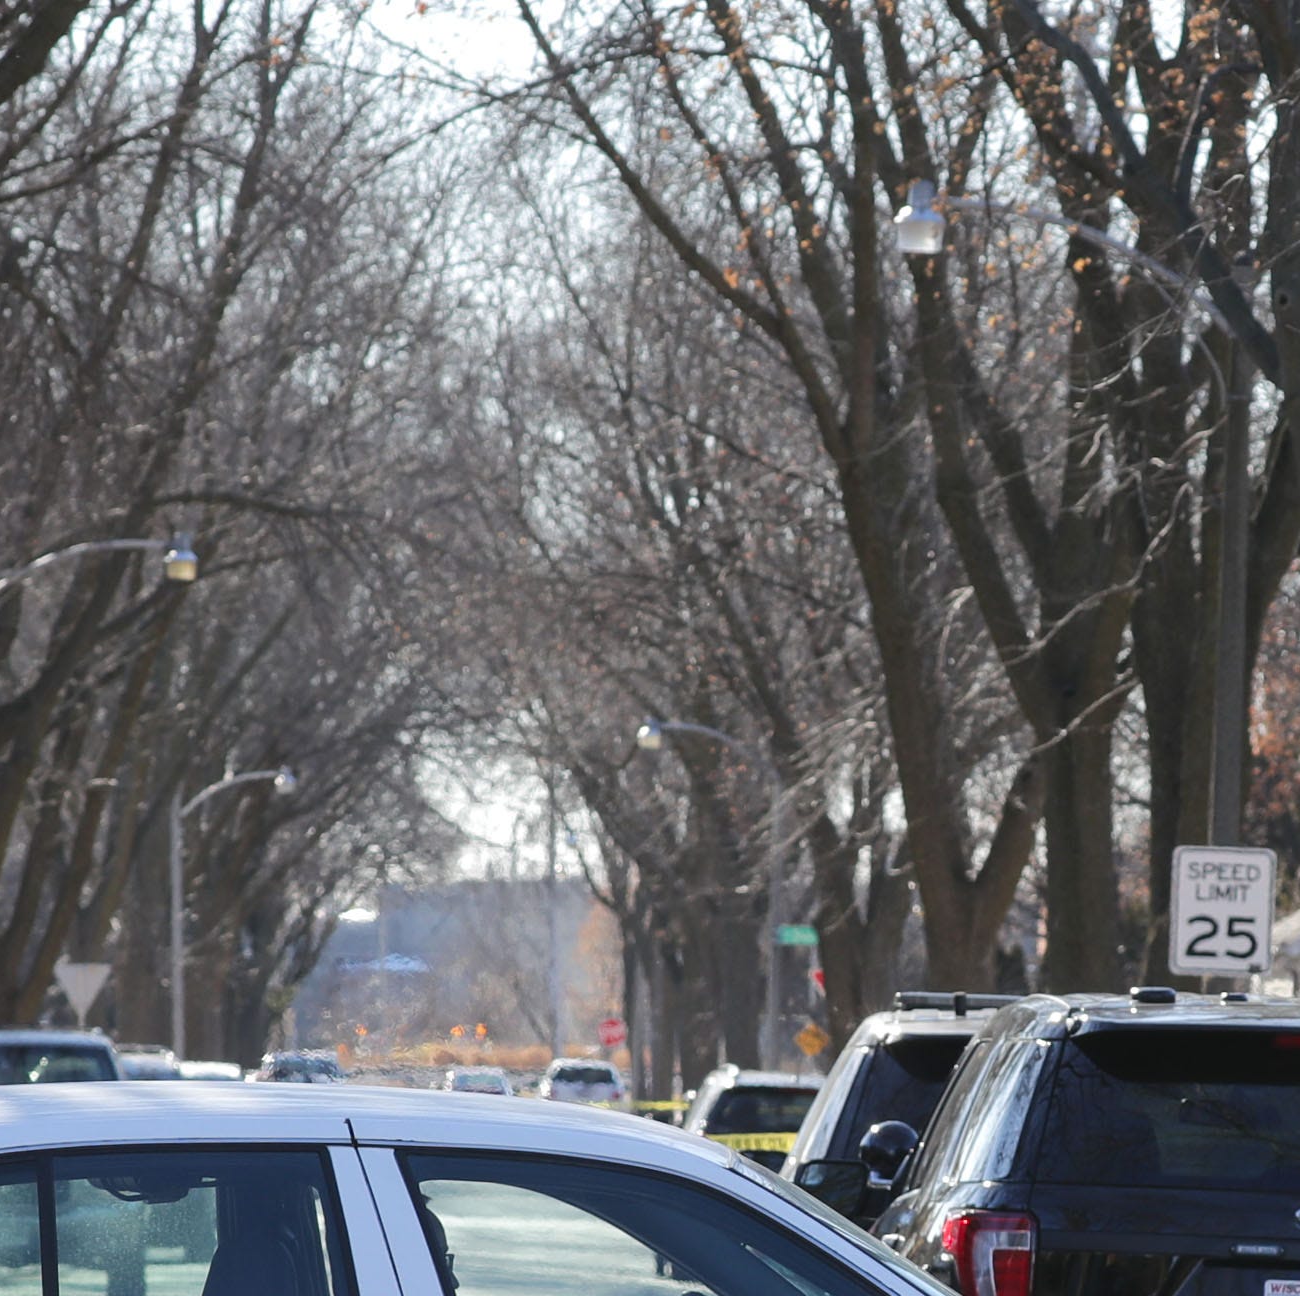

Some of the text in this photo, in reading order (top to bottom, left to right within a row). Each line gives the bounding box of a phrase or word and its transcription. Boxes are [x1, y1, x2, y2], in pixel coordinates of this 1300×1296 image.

[1187, 861, 1261, 882] SPEED
[1195, 883, 1251, 902] LIMIT
[1185, 915, 1257, 959] 25
